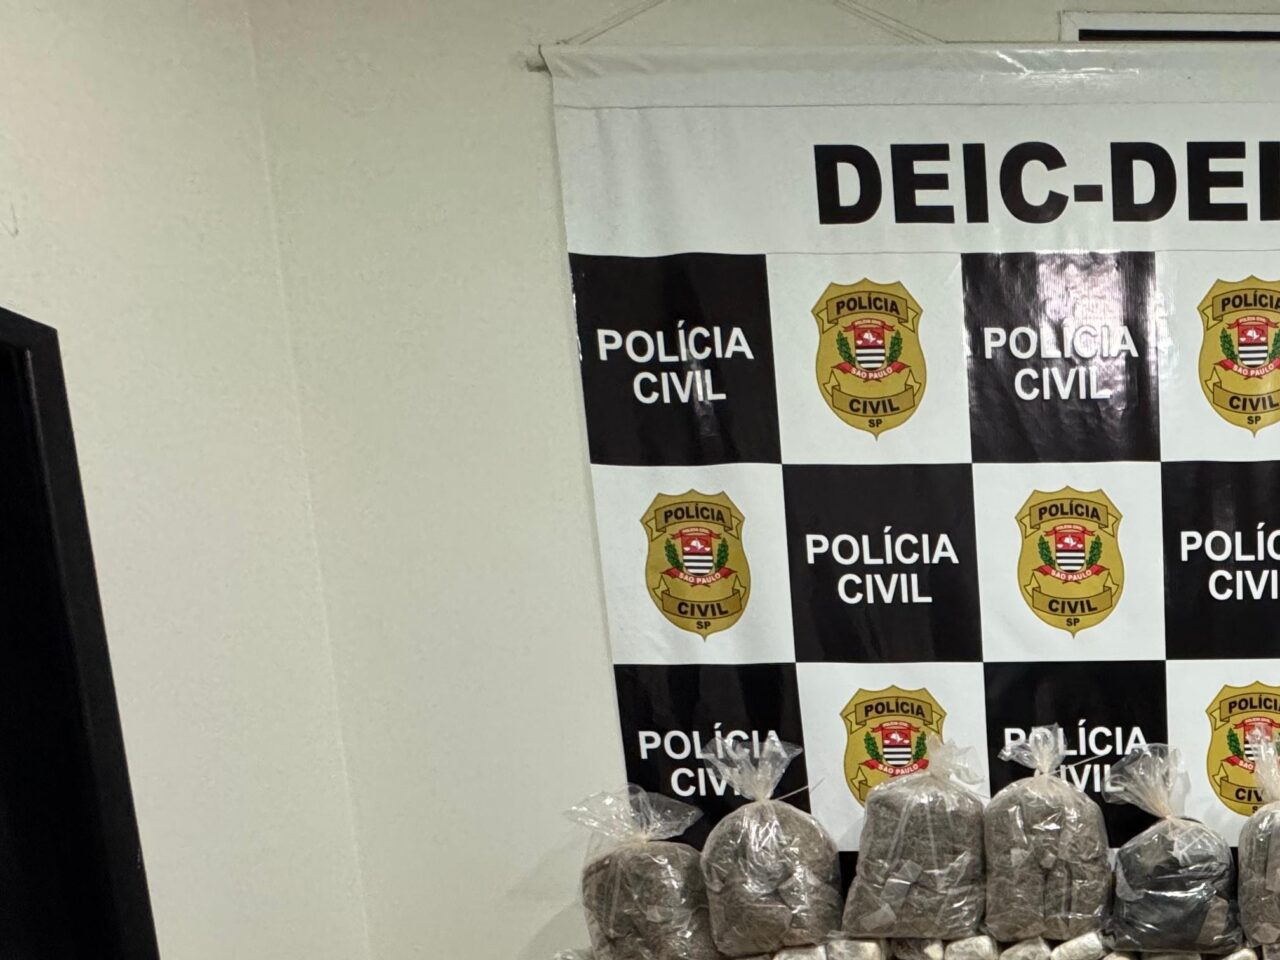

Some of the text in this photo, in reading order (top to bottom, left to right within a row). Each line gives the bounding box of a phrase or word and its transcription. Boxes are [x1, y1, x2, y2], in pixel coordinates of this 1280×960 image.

[836, 292, 900, 315] POLÍCIA
[598, 320, 753, 362] POLÍCIA
[984, 316, 1139, 359] POLÍCIA
[869, 367, 893, 379] PAULO
[1250, 363, 1275, 376] PAULO
[634, 370, 726, 403] CIVIL
[1014, 366, 1112, 400] CIVIL
[849, 399, 900, 414] CIVIL
[1229, 395, 1280, 411] CIVIL
[868, 419, 883, 428] SP
[1247, 416, 1261, 425] SP
[664, 503, 725, 524] POLÍCIA
[1038, 500, 1101, 521] POLÍCIA
[806, 526, 958, 564] POLÍCIA
[696, 572, 721, 584] PAULO
[1068, 570, 1092, 581] PAULO
[838, 574, 932, 603] CIVIL
[677, 602, 729, 617] CIVIL
[1048, 599, 1098, 614] CIVIL
[696, 621, 711, 630] SP
[1066, 618, 1080, 627] SP
[864, 699, 925, 717] POLÍCIA
[638, 722, 788, 760] POLÍCIA
[1004, 719, 1150, 756] POLÍCIA
[895, 764, 919, 775] PAULO
[1034, 764, 1124, 793] IVIL
[671, 767, 741, 797] CIV
